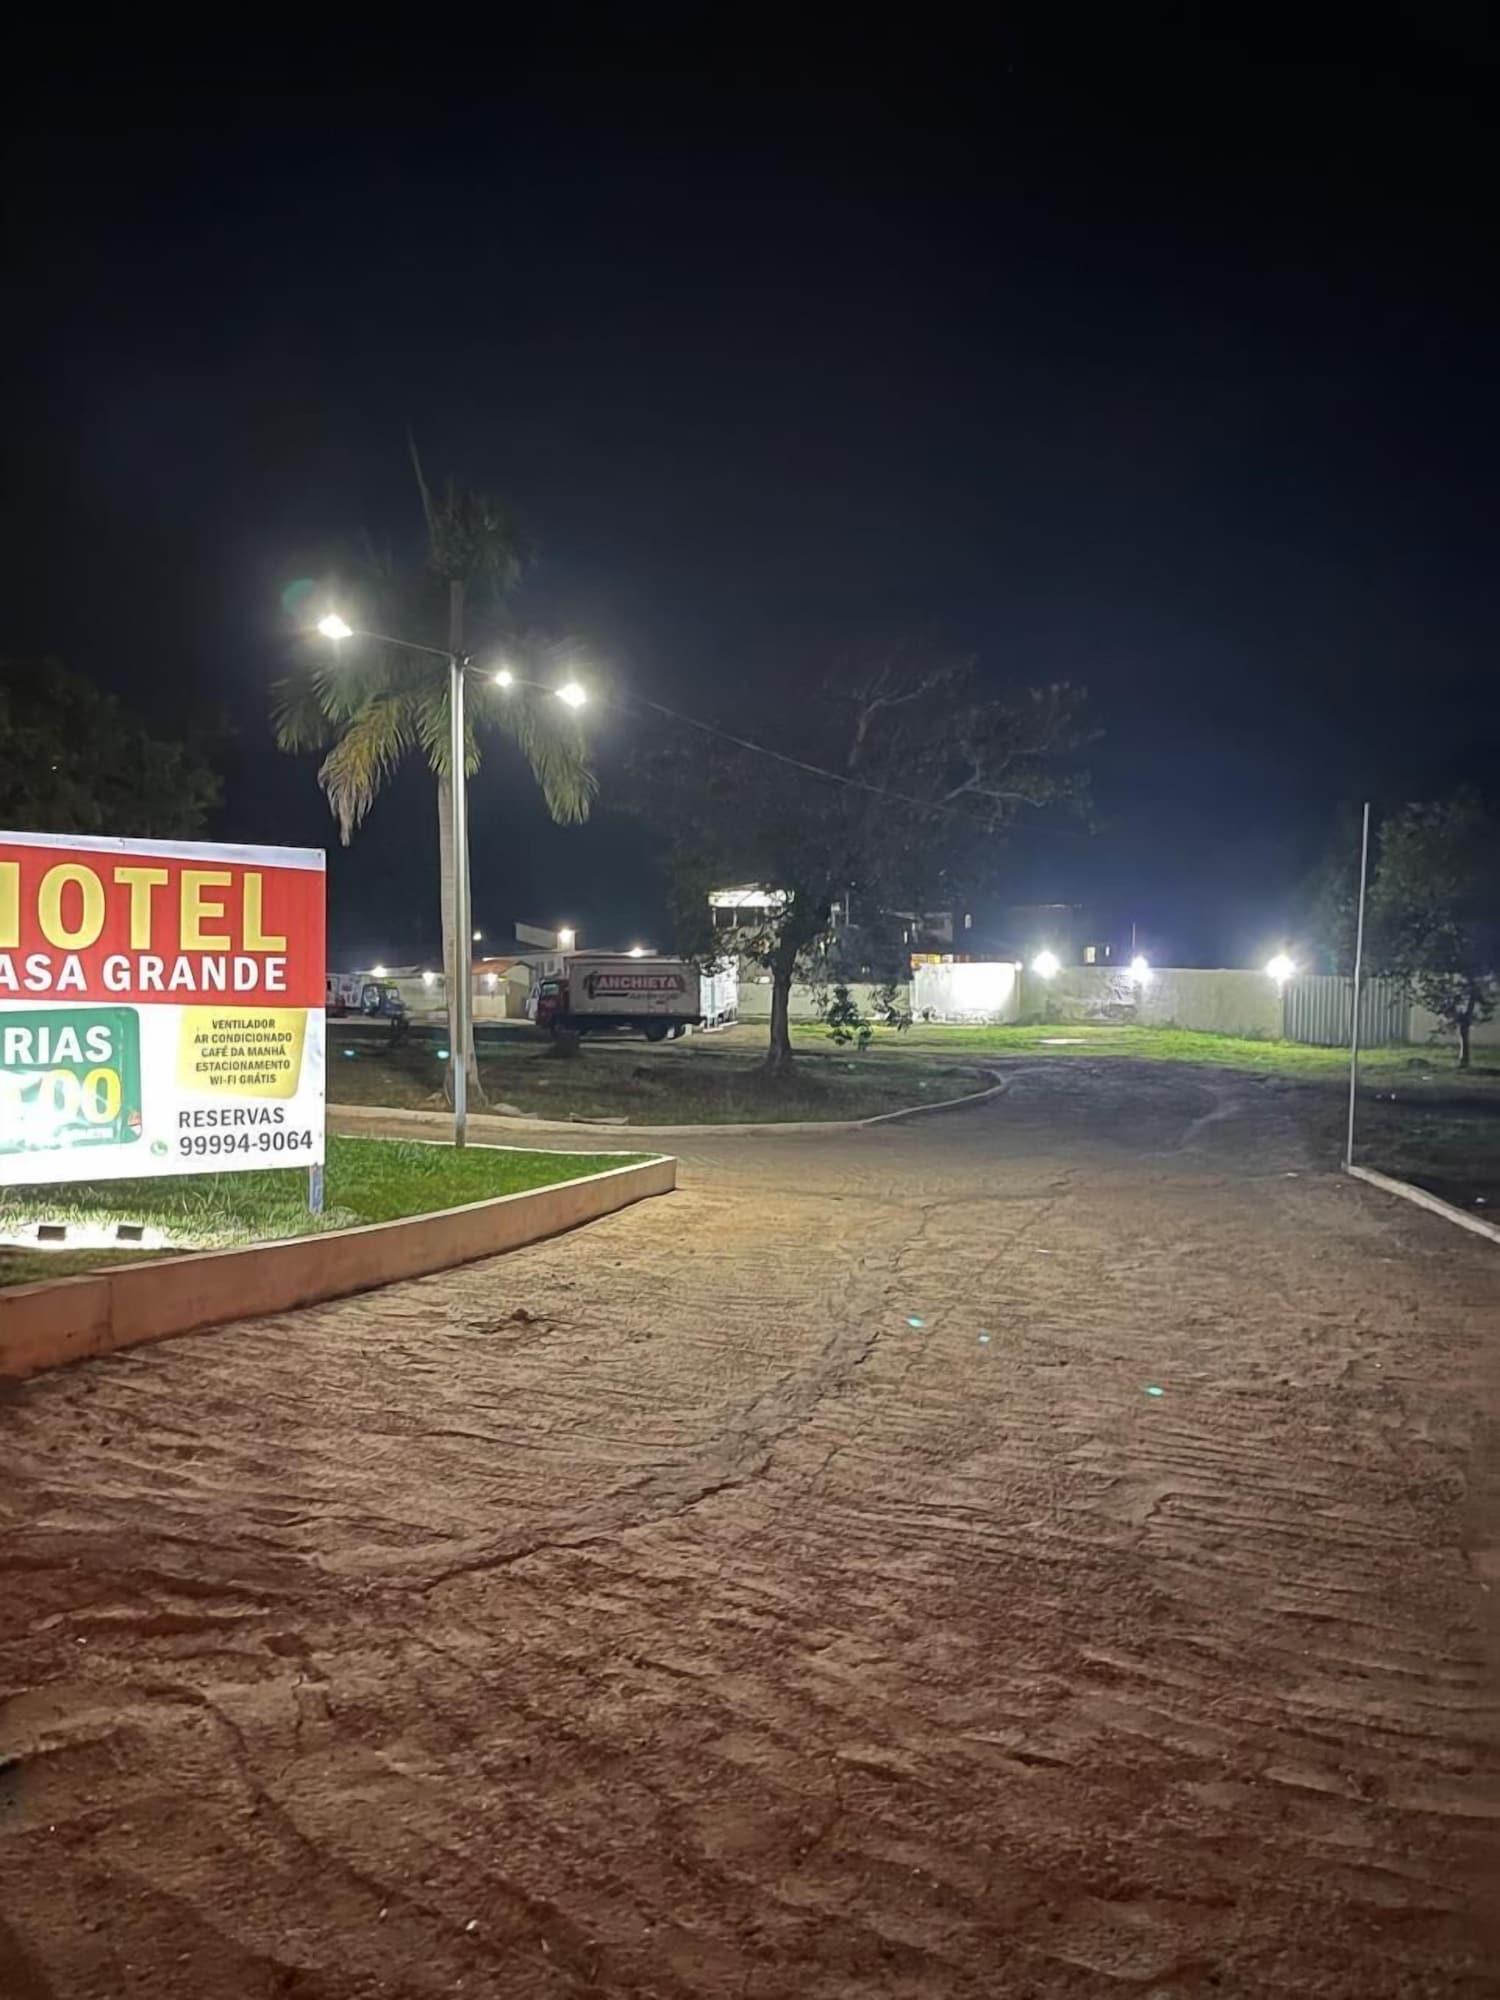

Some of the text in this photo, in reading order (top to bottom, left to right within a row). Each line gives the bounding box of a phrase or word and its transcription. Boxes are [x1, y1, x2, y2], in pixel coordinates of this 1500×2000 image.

[103, 954, 287, 992] GRANDE
[598, 976, 678, 988] ANCHIETA
[212, 1019, 276, 1030] VENTILADOR
[194, 1032, 293, 1044] AR CONDICIONADO
[201, 1045, 228, 1057] CAFÉ
[230, 1047, 245, 1057] DA
[196, 1060, 291, 1073] ESTACIONAMENTO
[210, 1072, 277, 1085] WI-FI GRÁTIS
[179, 1107, 285, 1129] RESERVAS
[179, 1130, 313, 1156] 99994-9064
